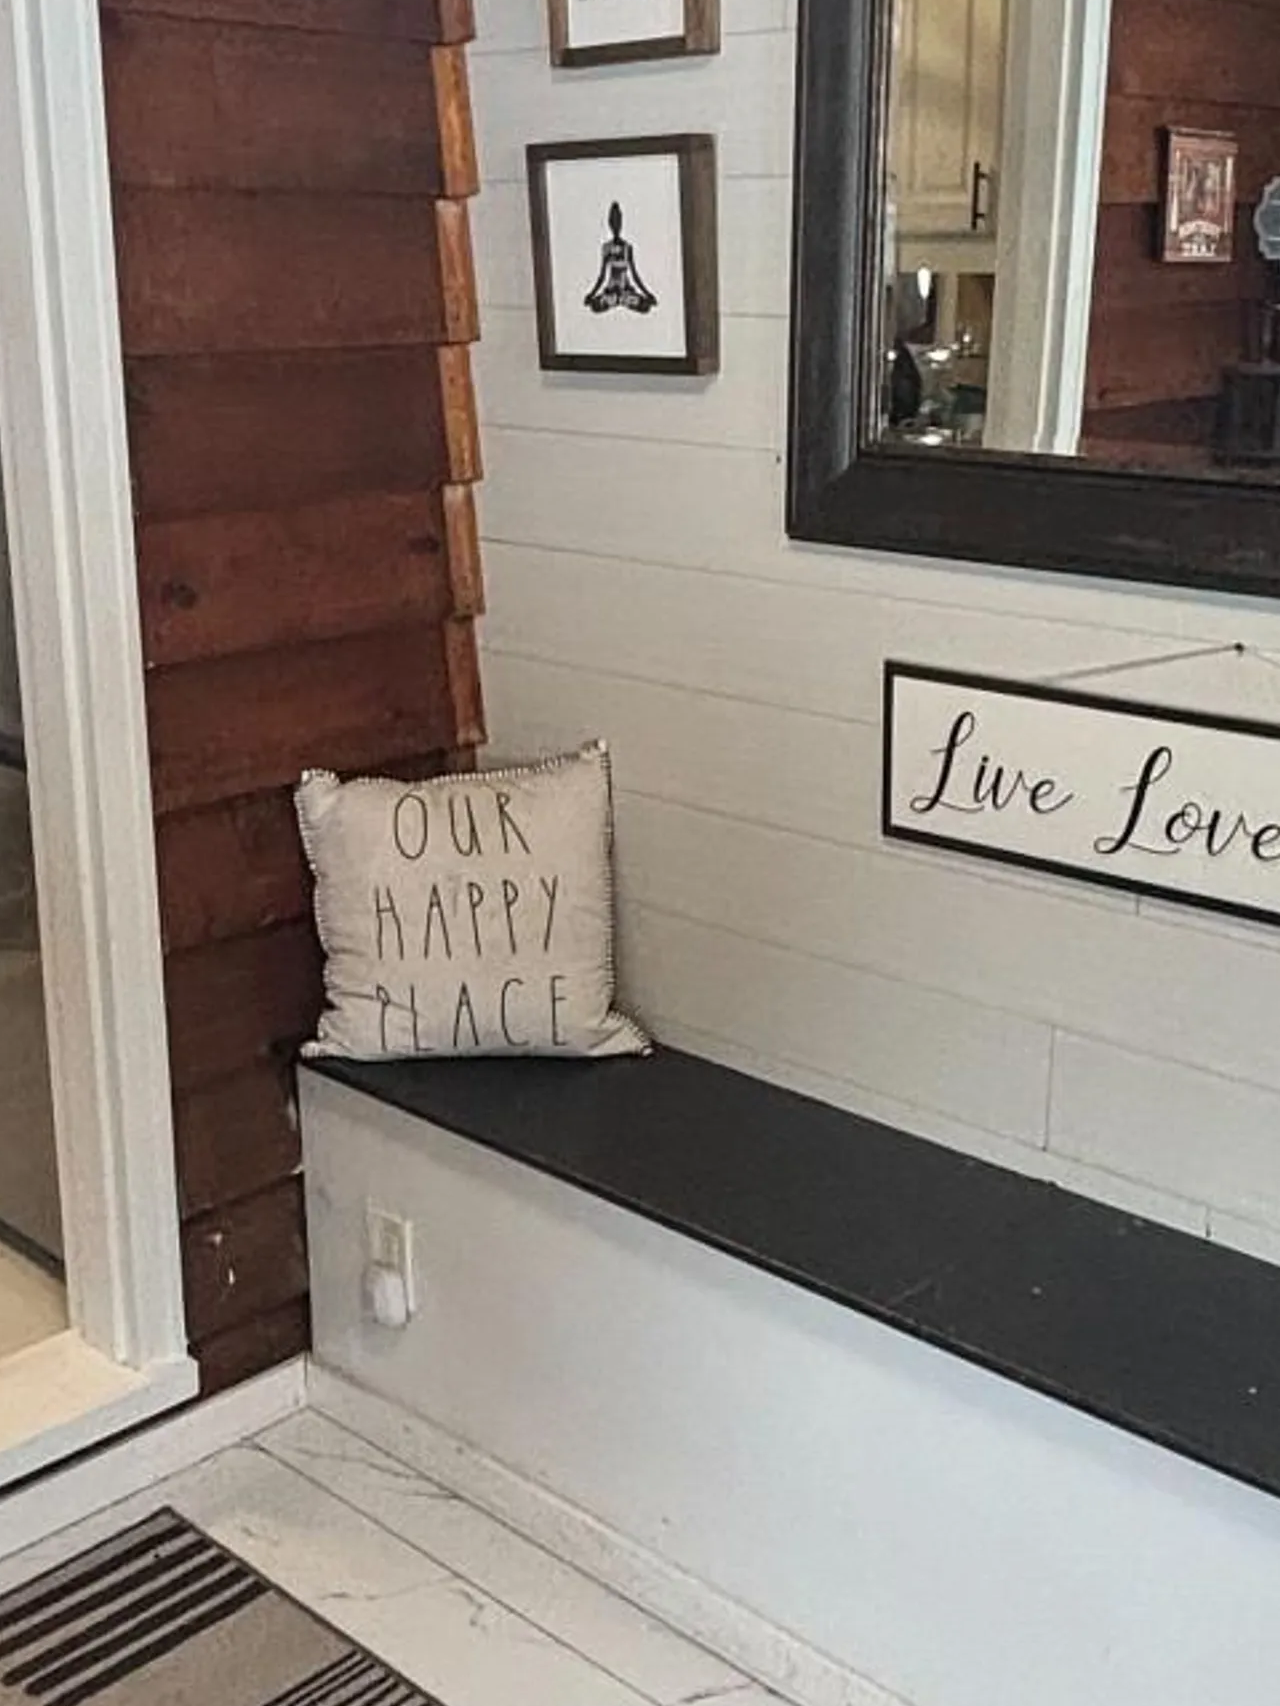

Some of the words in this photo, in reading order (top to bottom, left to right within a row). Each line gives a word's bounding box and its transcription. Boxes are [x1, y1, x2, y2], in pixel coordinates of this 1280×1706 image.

[910, 711, 1075, 815] Live
[394, 792, 531, 860] OUR
[374, 875, 558, 960] HAPPY
[375, 974, 567, 1052] PLACE
